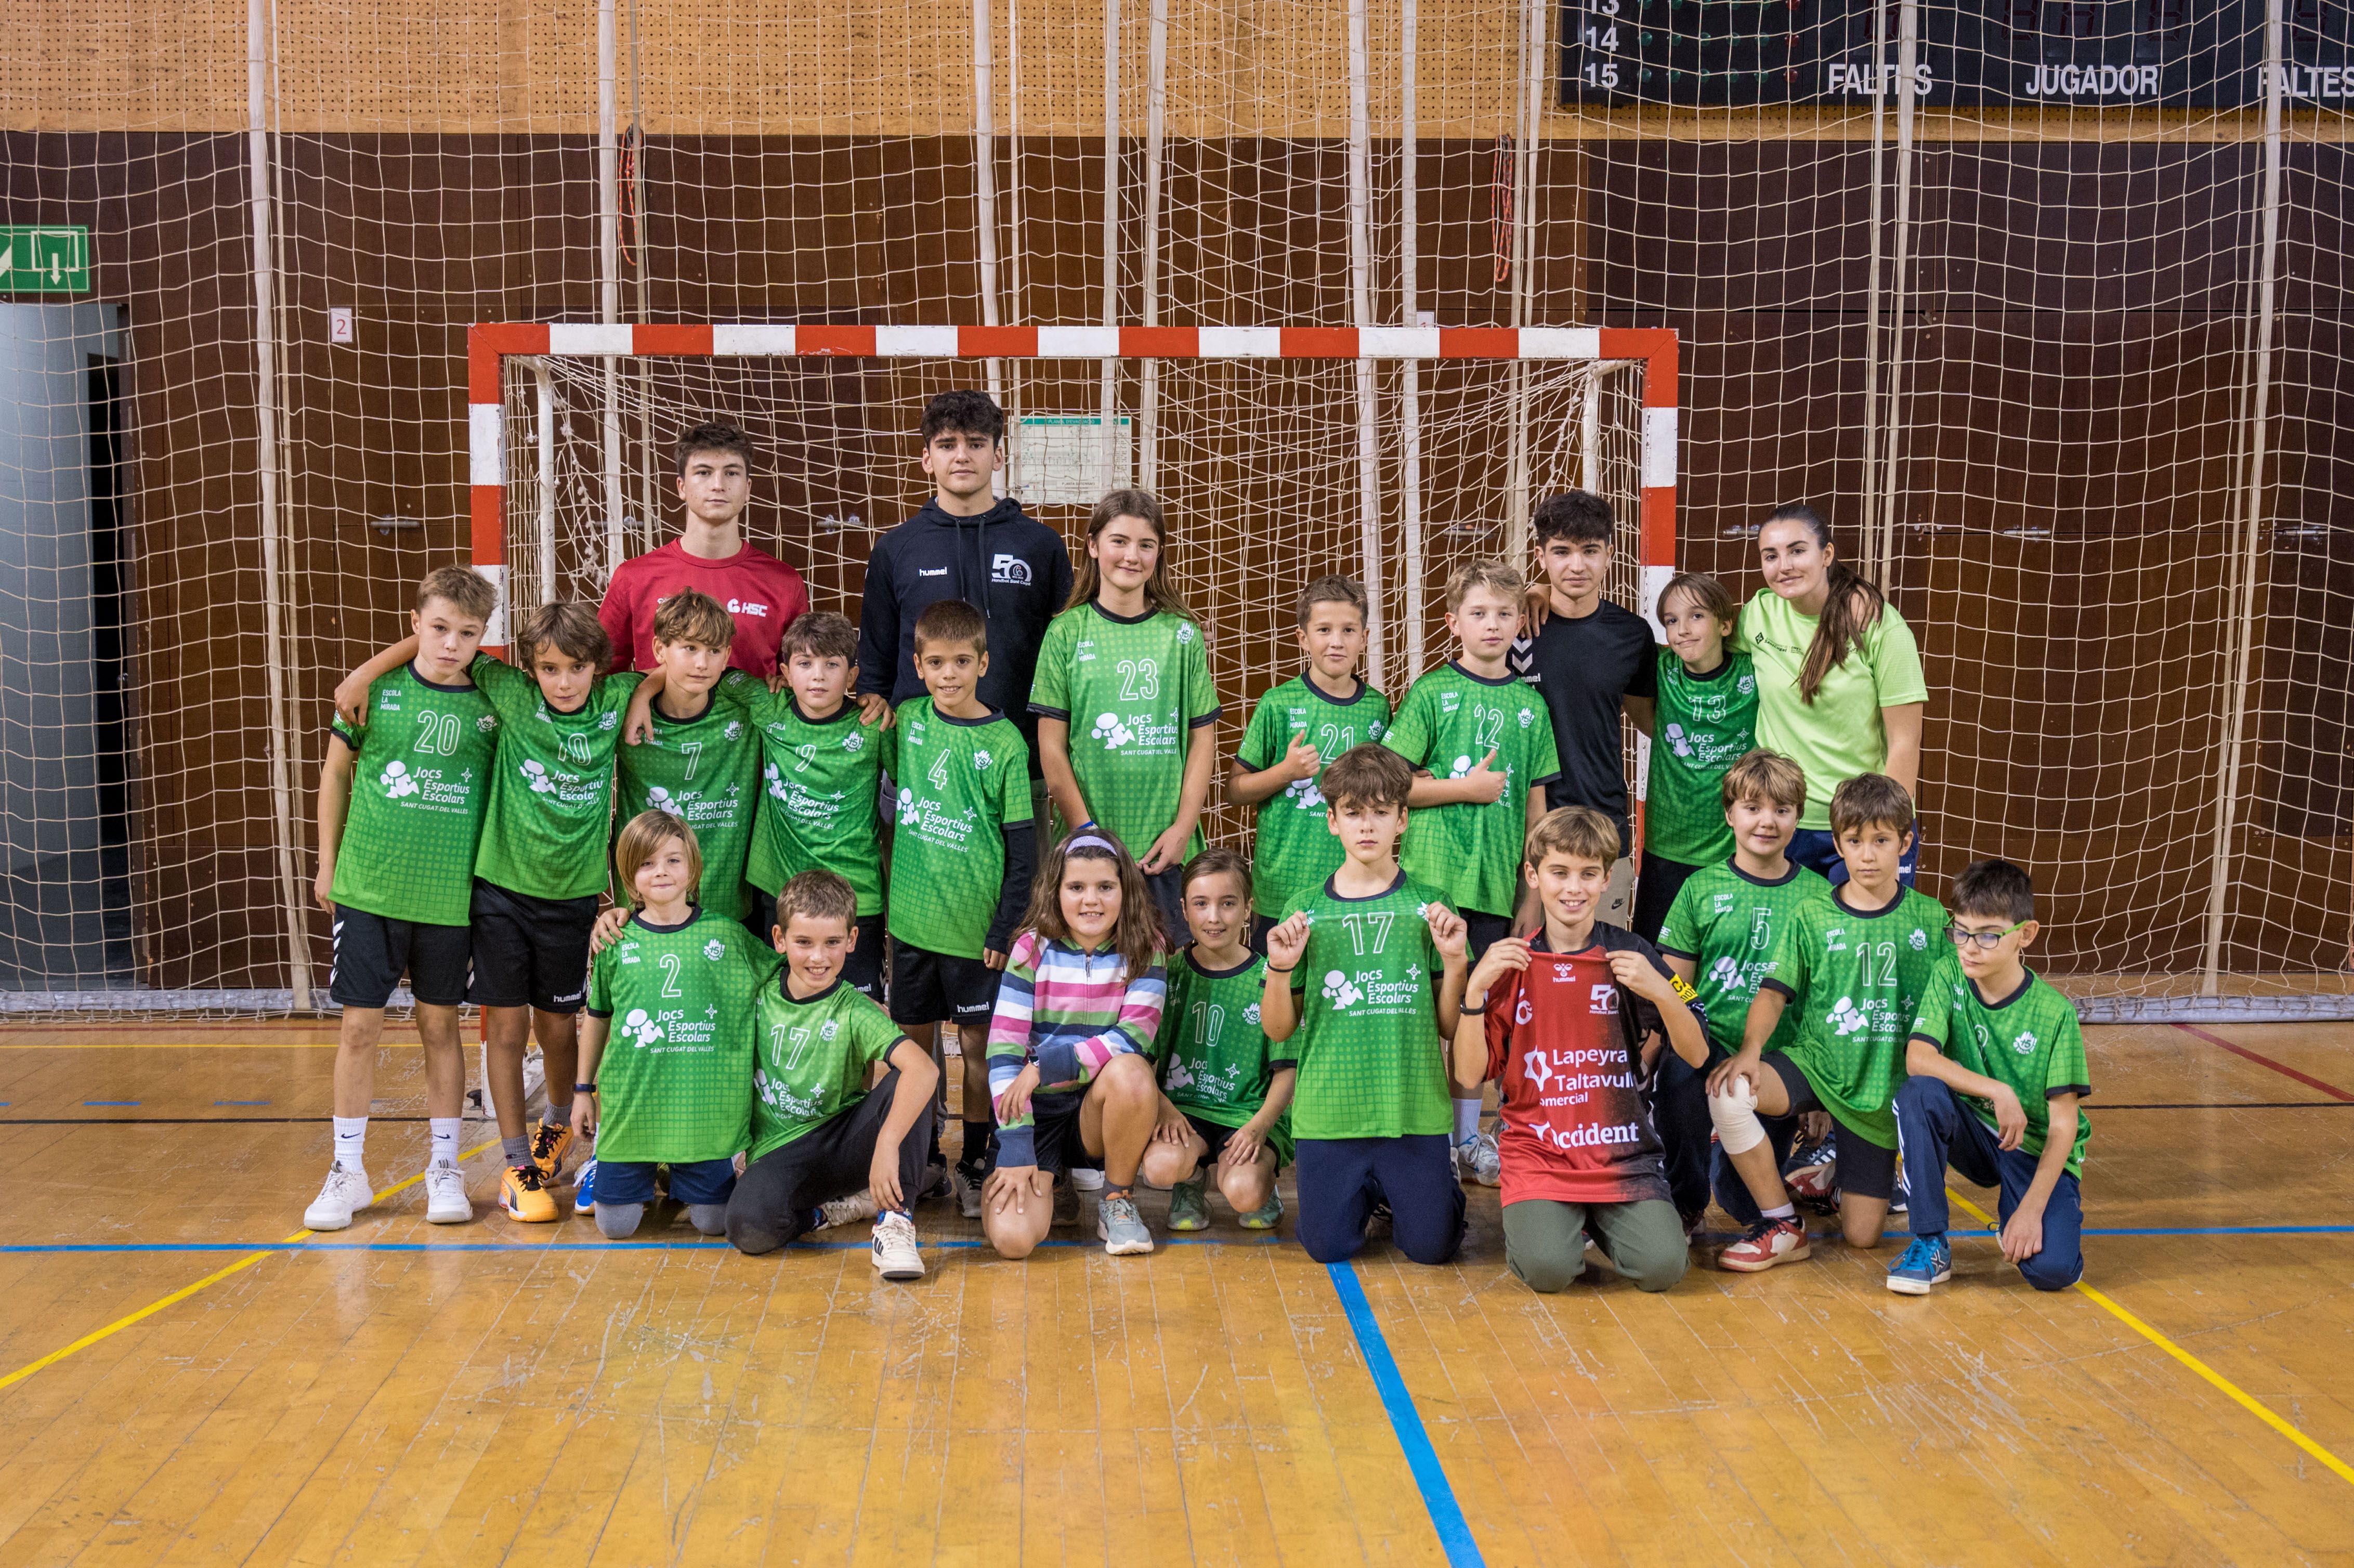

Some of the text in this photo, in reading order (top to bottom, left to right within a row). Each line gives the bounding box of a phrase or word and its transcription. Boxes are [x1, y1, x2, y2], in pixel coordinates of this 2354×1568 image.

[1586, 27, 1619, 51] 14
[1585, 63, 1618, 87] 15
[2026, 64, 2157, 95] JUGADOR
[336, 319, 347, 335] 2
[919, 566, 947, 577] hummel
[741, 602, 768, 618] HSC
[1079, 654, 1096, 662] MIRADA
[1117, 658, 1159, 701] 23
[1688, 695, 1726, 723] 13
[911, 721, 925, 731] ESCOLA
[1127, 714, 1152, 726] Jocs
[1474, 704, 1504, 750] 22
[414, 710, 461, 756] 20
[1139, 735, 1176, 746] Escolars
[1688, 731, 1715, 743] Jocs
[1319, 724, 1354, 764] 21
[1698, 742, 1747, 755] Esportius
[682, 742, 702, 780] 7
[1698, 752, 1742, 763] Escolars
[413, 766, 442, 779] Jocs
[551, 770, 580, 783] Jocs
[928, 748, 951, 790] 4
[424, 779, 470, 794] Esportius
[560, 780, 604, 794] Esportiu
[783, 778, 807, 794] Jocs
[422, 790, 465, 804] Escolars
[559, 791, 597, 801] Escola
[676, 790, 703, 802] Jocs
[790, 790, 839, 812] Esportius
[687, 798, 738, 812] Esportius
[788, 801, 832, 819] Escolars
[917, 796, 941, 812] Jocs
[687, 809, 733, 820] Escolars
[923, 810, 973, 833] Esportius
[908, 829, 918, 838] SANT
[918, 831, 935, 843] CUGAT
[935, 839, 946, 847] DEL
[921, 820, 965, 842] Escolars
[1342, 911, 1394, 956] 17
[1750, 907, 1771, 950] 5
[1826, 928, 1845, 937] ESCOLA
[622, 942, 639, 951] ESCOLA
[622, 956, 640, 965] MIRADA
[1741, 960, 1767, 972] Jocs
[1856, 942, 1897, 987] 12
[660, 953, 682, 998] 2
[1354, 970, 1383, 984] Jocs
[1367, 979, 1419, 995] Esportius
[554, 990, 581, 1003] hummel
[1368, 992, 1411, 1005] Escolars
[957, 1001, 990, 1014] hummel
[1860, 998, 1888, 1011] Jocs
[656, 1009, 684, 1023] Jocs
[668, 1020, 715, 1034] Esportius
[1192, 1001, 1224, 1047] 10
[668, 1031, 710, 1043] Escolars
[770, 1024, 810, 1070] 17
[1189, 1057, 1208, 1069] Jocs
[1553, 1048, 1628, 1067] Lapeyra
[1198, 1070, 1235, 1090] Esportius
[1196, 1081, 1227, 1100] Escolars
[779, 1091, 823, 1108] Esportius
[1540, 1092, 1588, 1107] omercial
